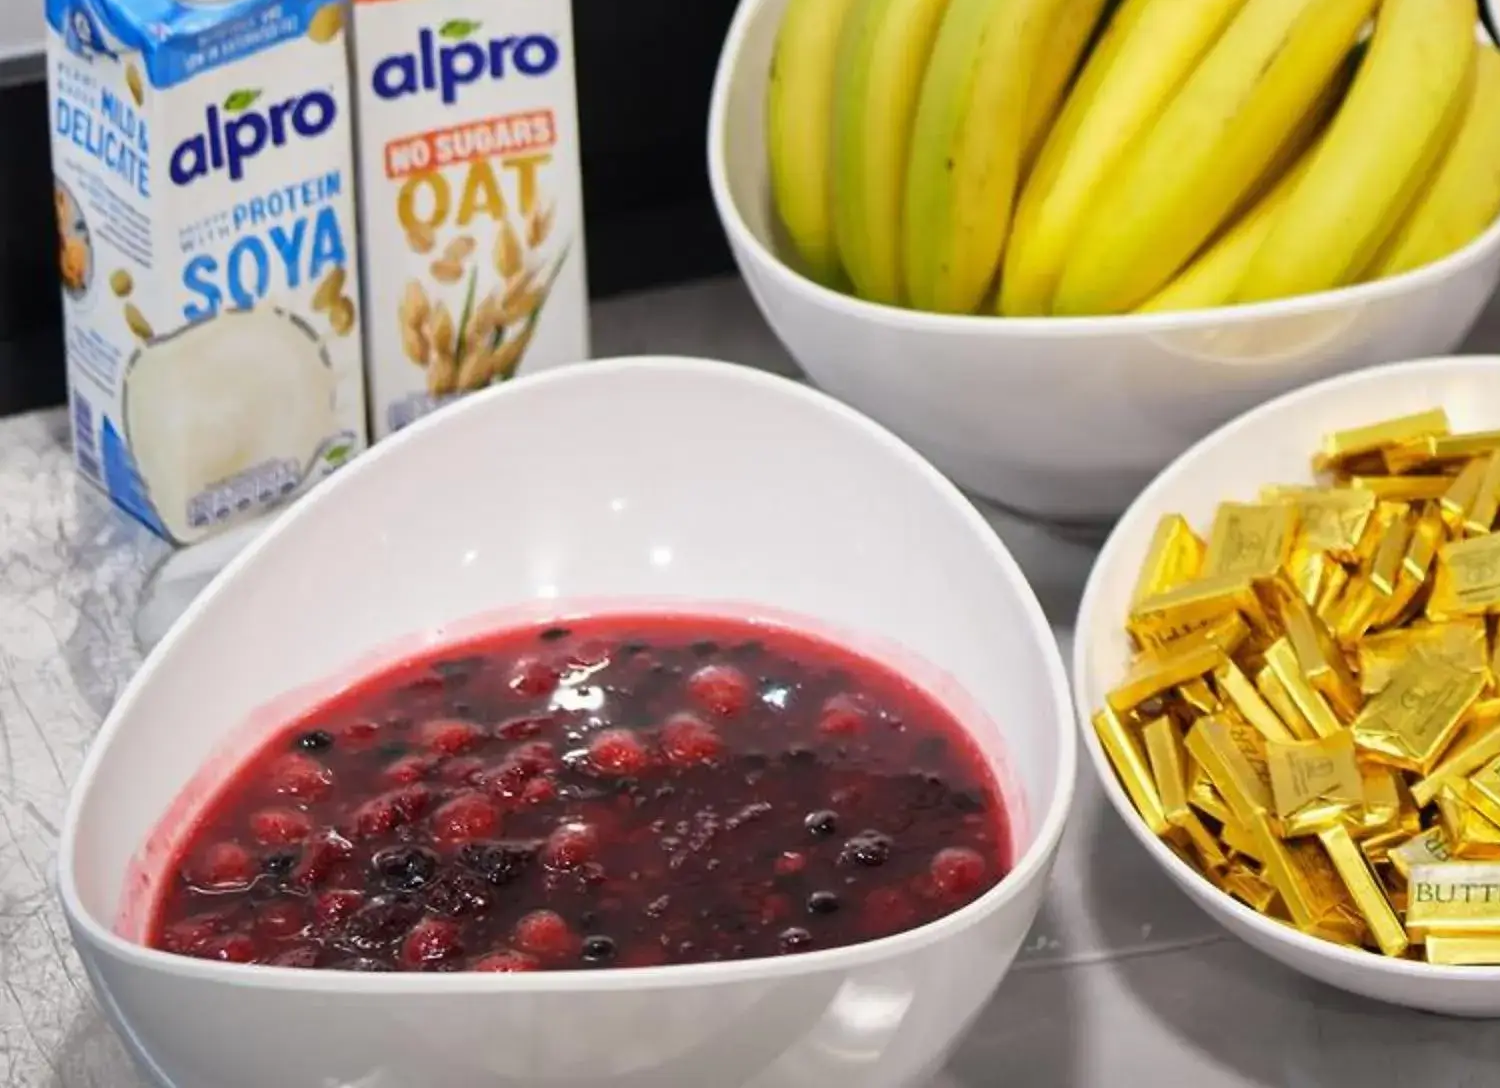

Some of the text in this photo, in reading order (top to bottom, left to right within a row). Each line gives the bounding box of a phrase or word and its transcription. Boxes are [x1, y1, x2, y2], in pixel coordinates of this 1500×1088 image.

[372, 27, 559, 105] alpro
[57, 97, 151, 198] DELICATE
[169, 90, 336, 186] alpro
[390, 116, 550, 172] NO SUGARS
[233, 170, 341, 230] PROTEIN
[397, 153, 553, 231] OAT
[182, 205, 347, 323] SOYA
